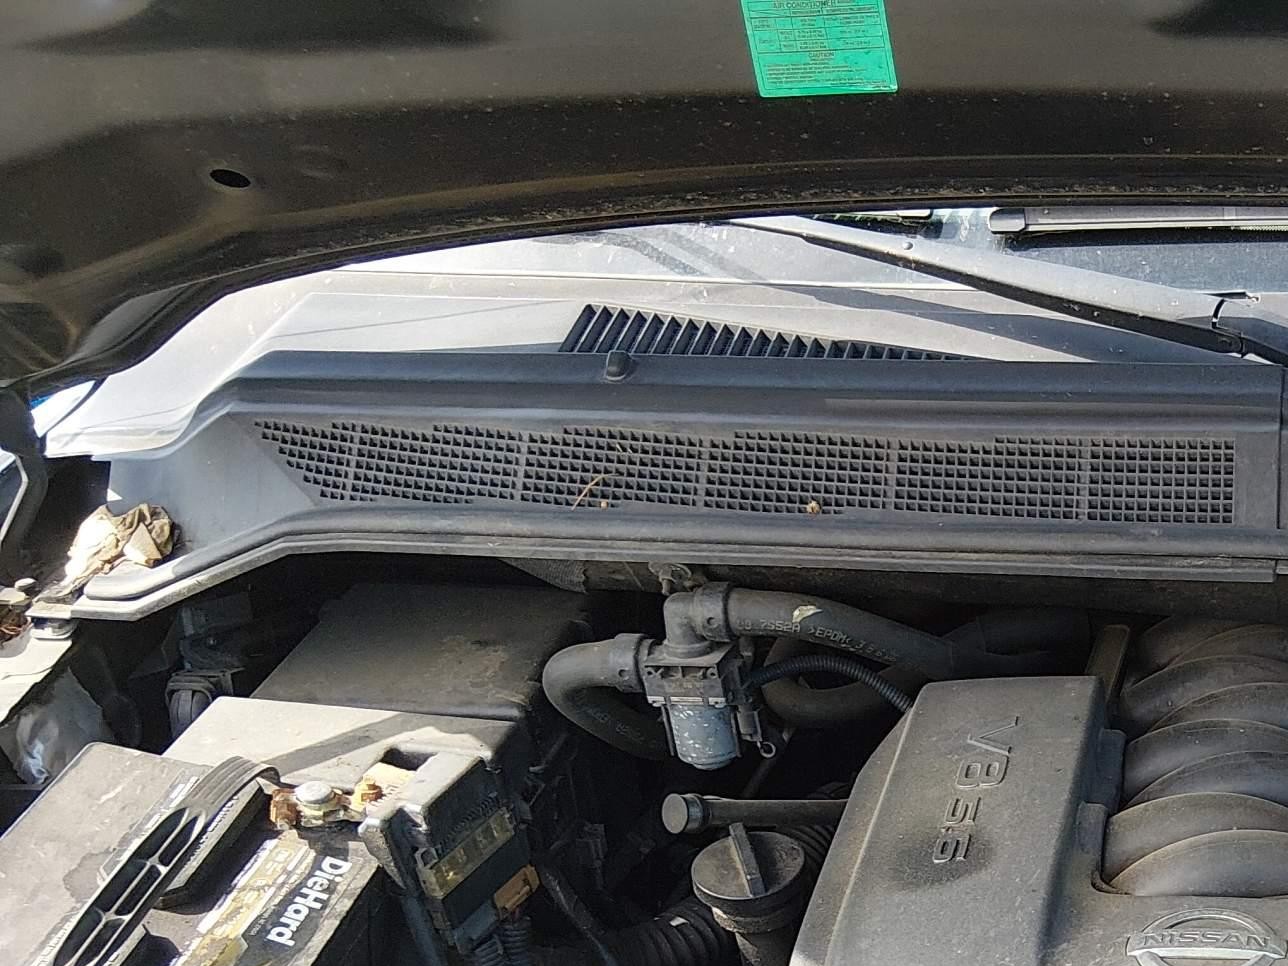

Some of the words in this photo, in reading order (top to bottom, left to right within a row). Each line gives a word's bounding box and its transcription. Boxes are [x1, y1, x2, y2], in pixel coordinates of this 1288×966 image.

[955, 716, 1020, 788] V8
[265, 855, 353, 947] DieHard
[1142, 929, 1271, 948] NISSAN
